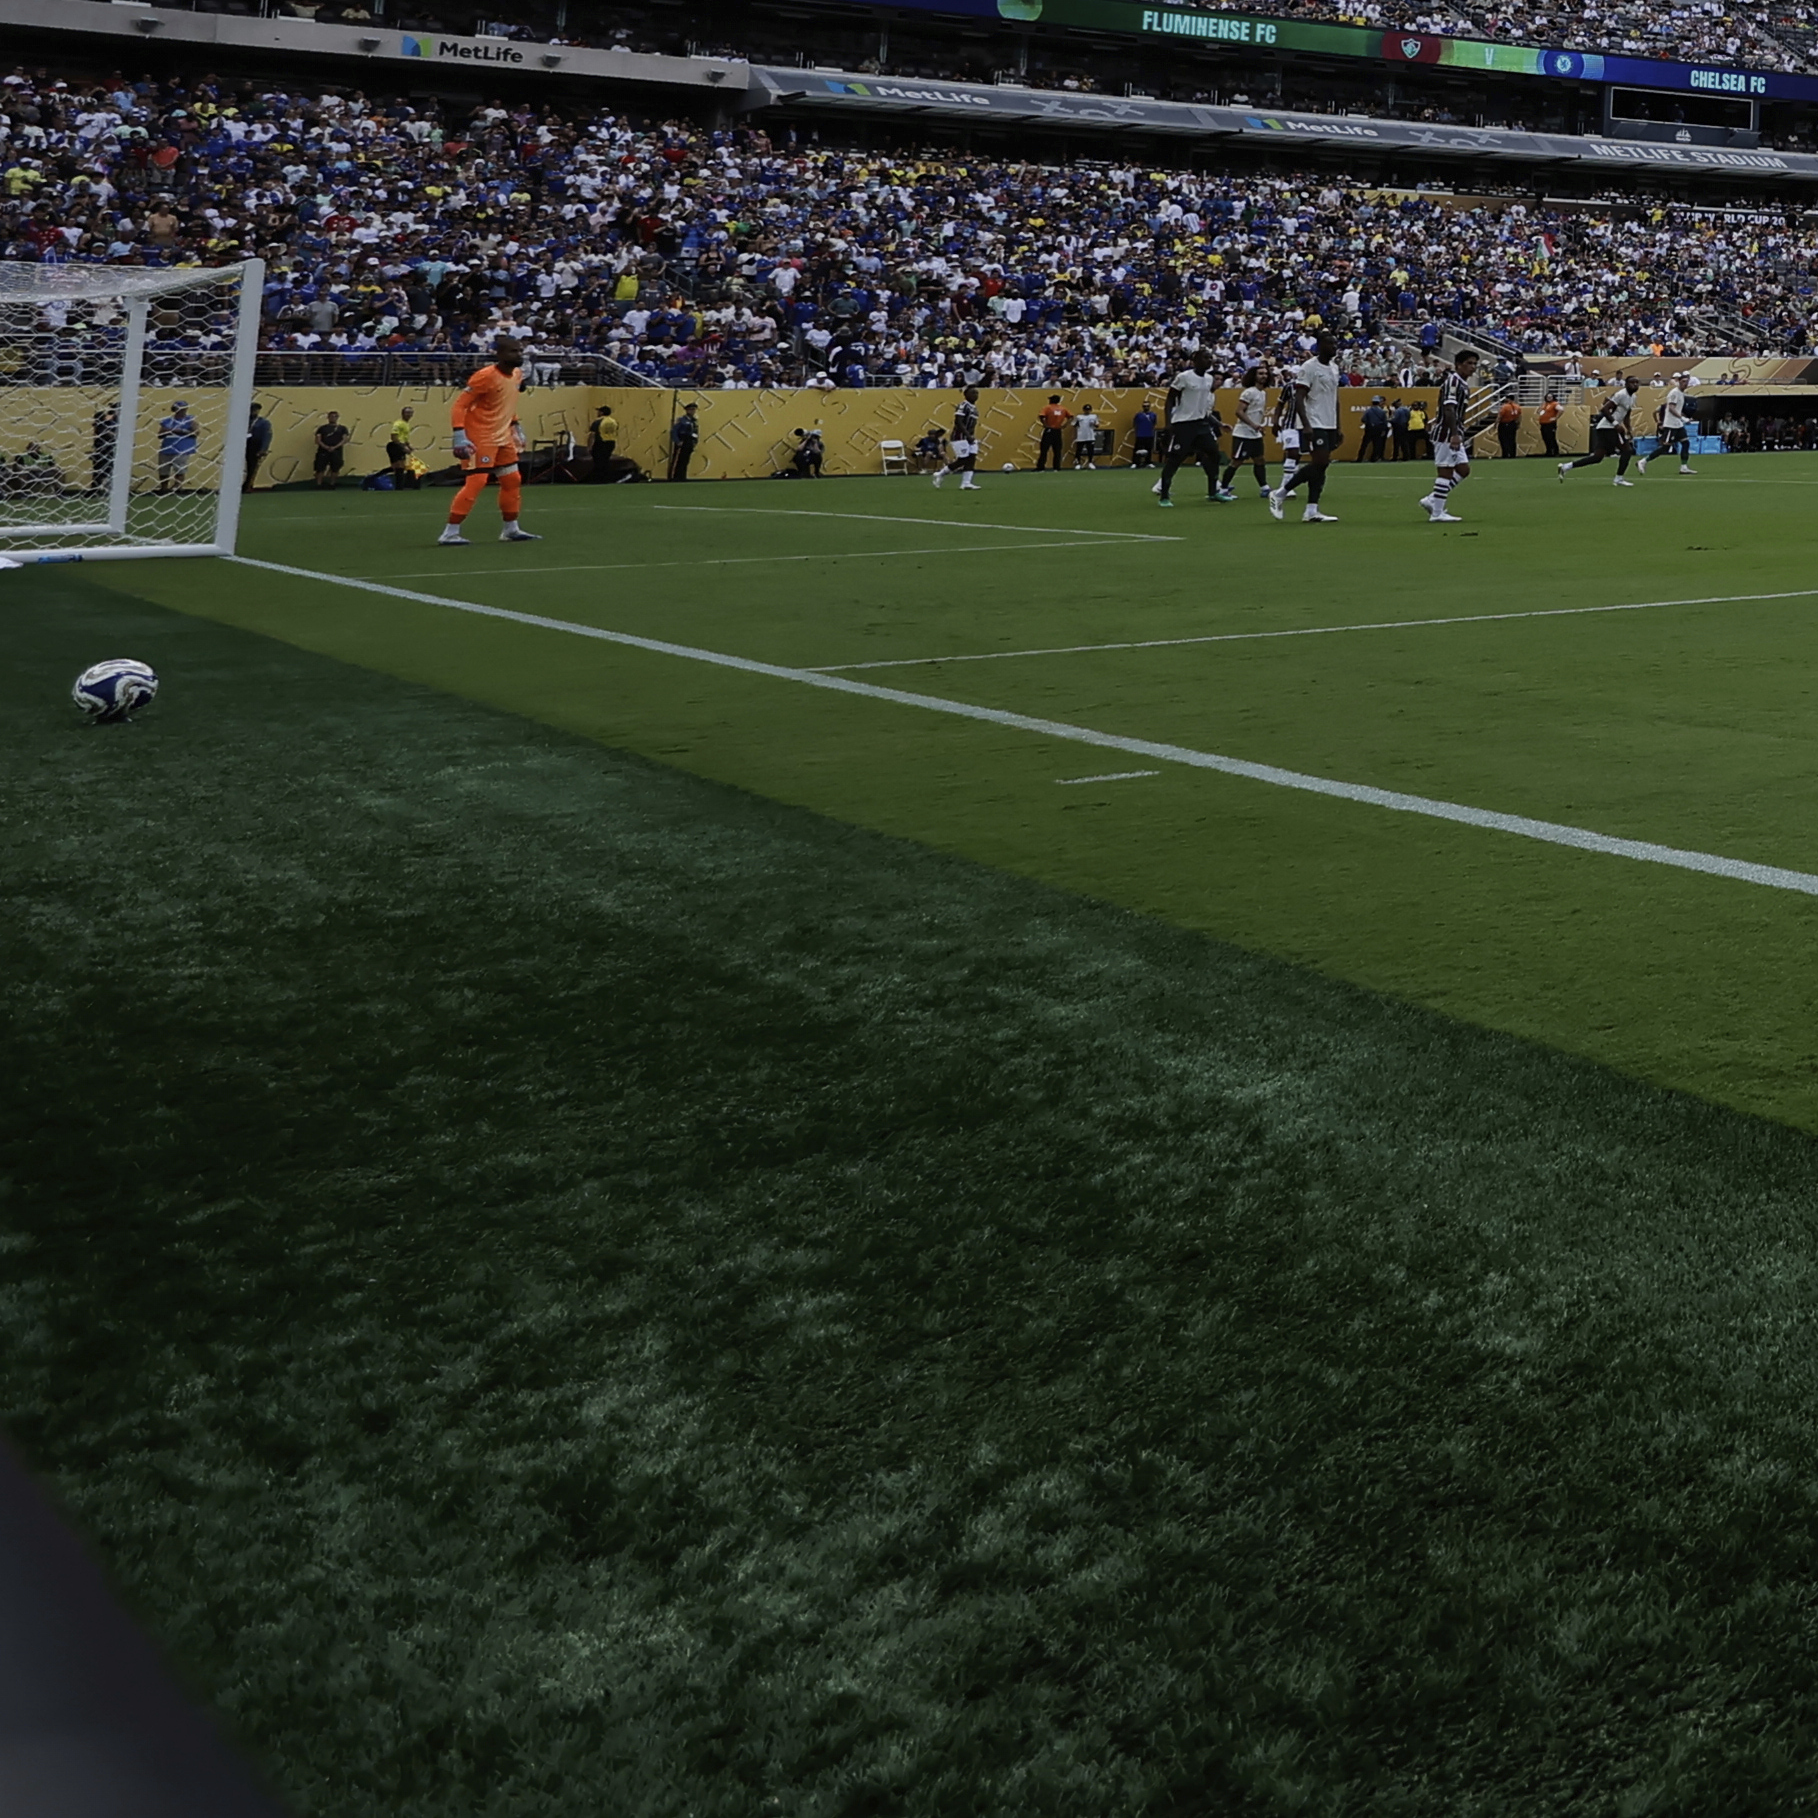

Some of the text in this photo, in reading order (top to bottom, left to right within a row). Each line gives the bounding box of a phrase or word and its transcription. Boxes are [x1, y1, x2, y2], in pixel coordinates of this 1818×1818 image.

[1142, 10, 1278, 45] FLUMINENSE FC
[439, 41, 524, 62] MetLife
[1690, 69, 1767, 94] CHELSEA FC
[876, 86, 991, 105] MetLife
[1286, 121, 1379, 137] MetLife
[1590, 144, 1789, 169] METLIFE STADIUM
